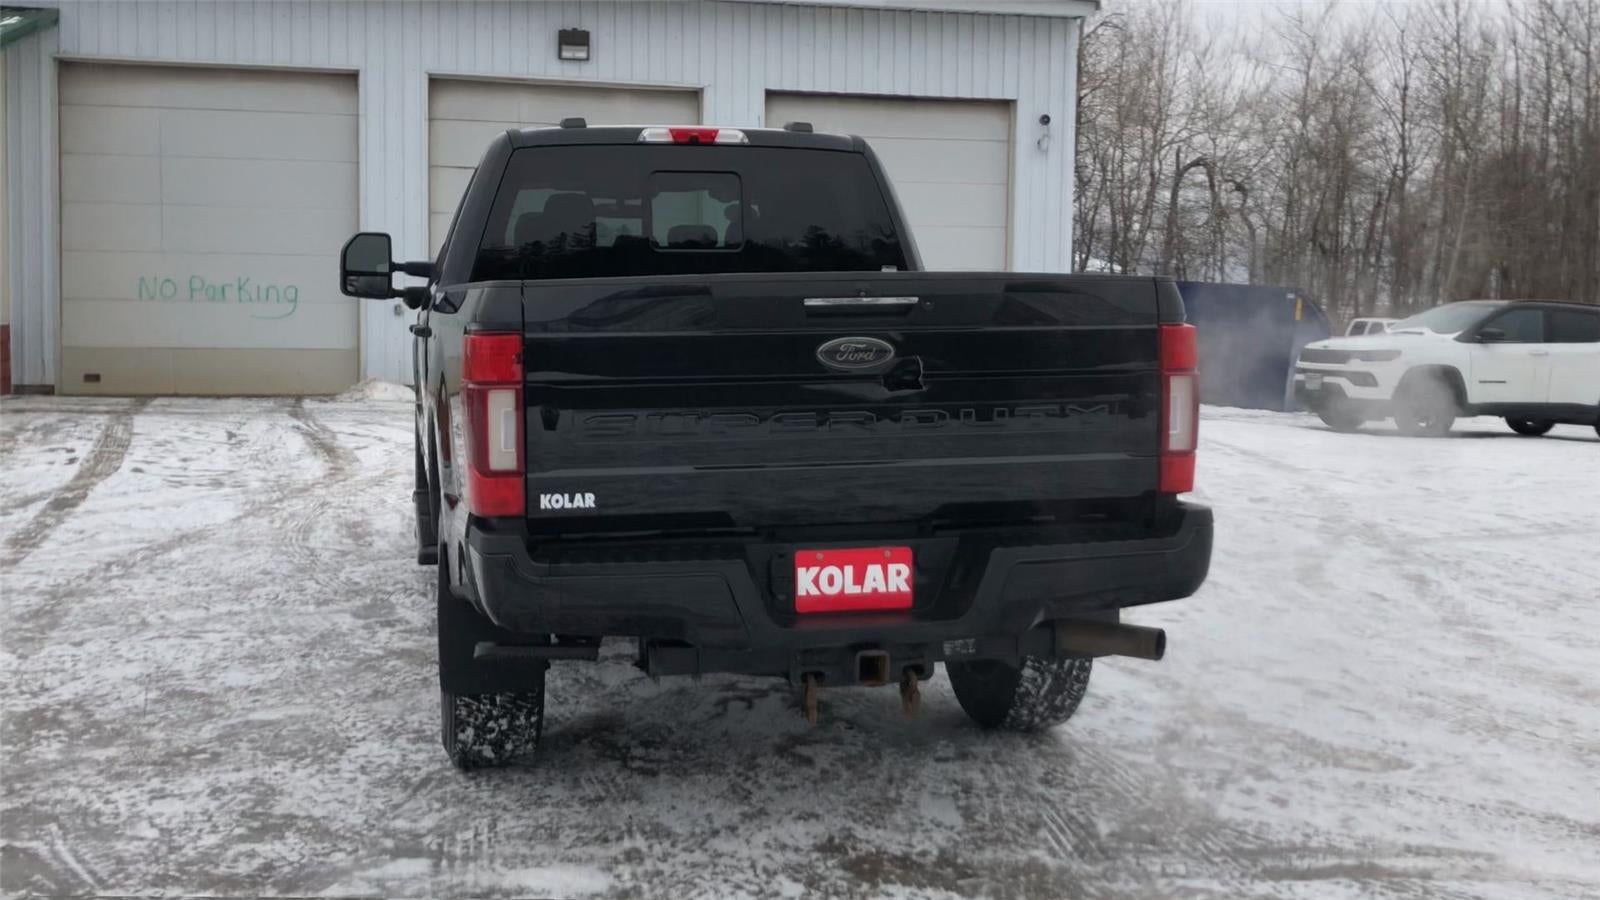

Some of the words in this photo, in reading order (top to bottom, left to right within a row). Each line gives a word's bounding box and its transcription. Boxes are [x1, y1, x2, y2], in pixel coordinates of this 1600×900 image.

[836, 343, 877, 361] Ford
[540, 492, 596, 509] KOLAR
[797, 563, 910, 596] KOLAR
